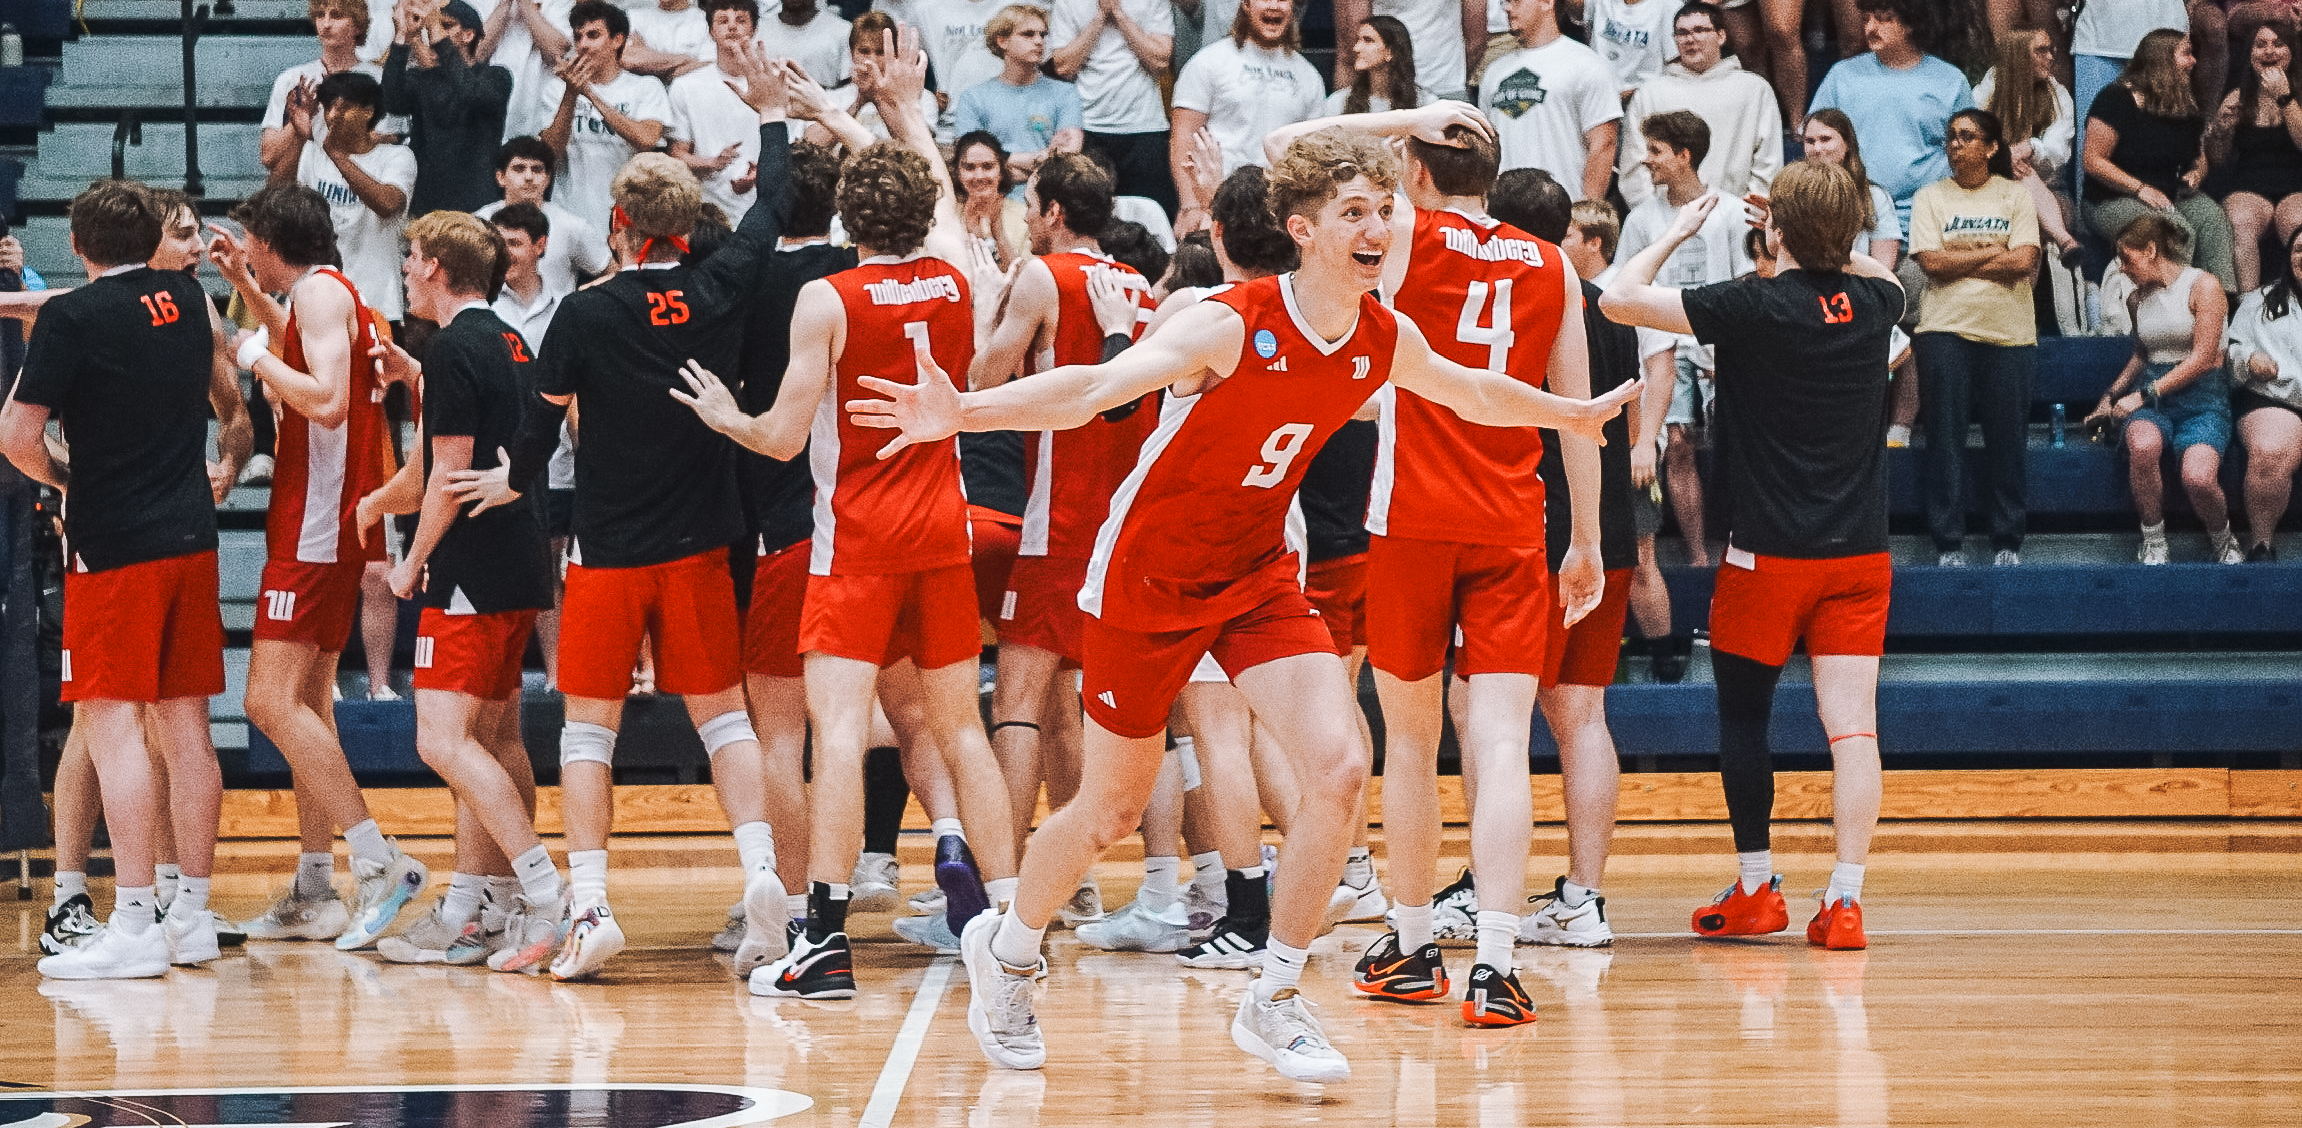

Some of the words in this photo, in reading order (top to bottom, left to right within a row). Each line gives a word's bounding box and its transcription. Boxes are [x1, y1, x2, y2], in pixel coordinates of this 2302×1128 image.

[140, 290, 180, 327] 16
[646, 289, 690, 326] 25
[1456, 278, 1516, 374] 4
[1818, 291, 1854, 324] 13
[1241, 422, 1315, 489] 9
